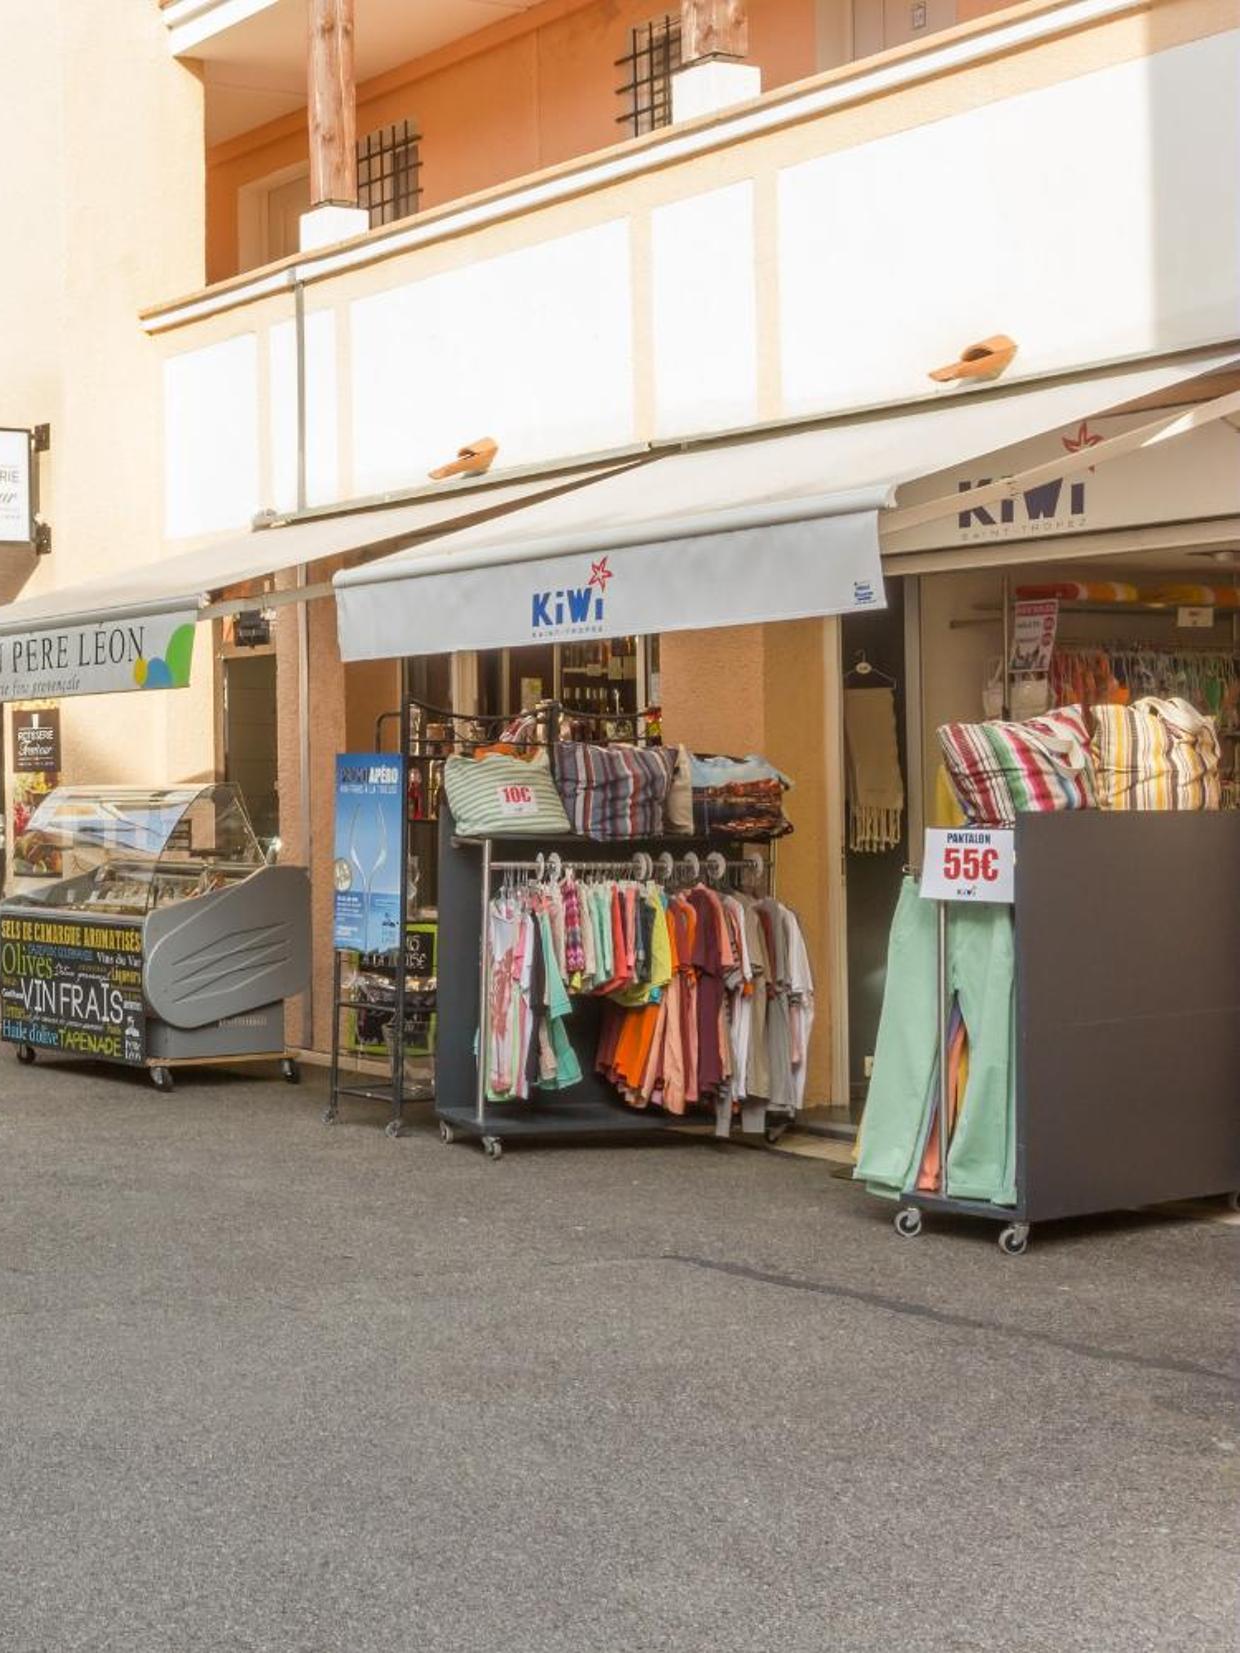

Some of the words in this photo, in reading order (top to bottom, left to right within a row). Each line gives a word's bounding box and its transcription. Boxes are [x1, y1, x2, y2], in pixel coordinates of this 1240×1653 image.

[79, 622, 146, 667] LÉON
[947, 833, 991, 844] PANTALON
[943, 848, 999, 881] 55€
[1, 919, 21, 939] SELS
[22, 921, 33, 941] DE
[34, 922, 81, 946] CAMARGUE
[2, 943, 53, 979] Olives
[21, 978, 56, 1013] VIN
[60, 983, 124, 1024] FRAIS
[58, 1027, 122, 1057] TAPENADE
